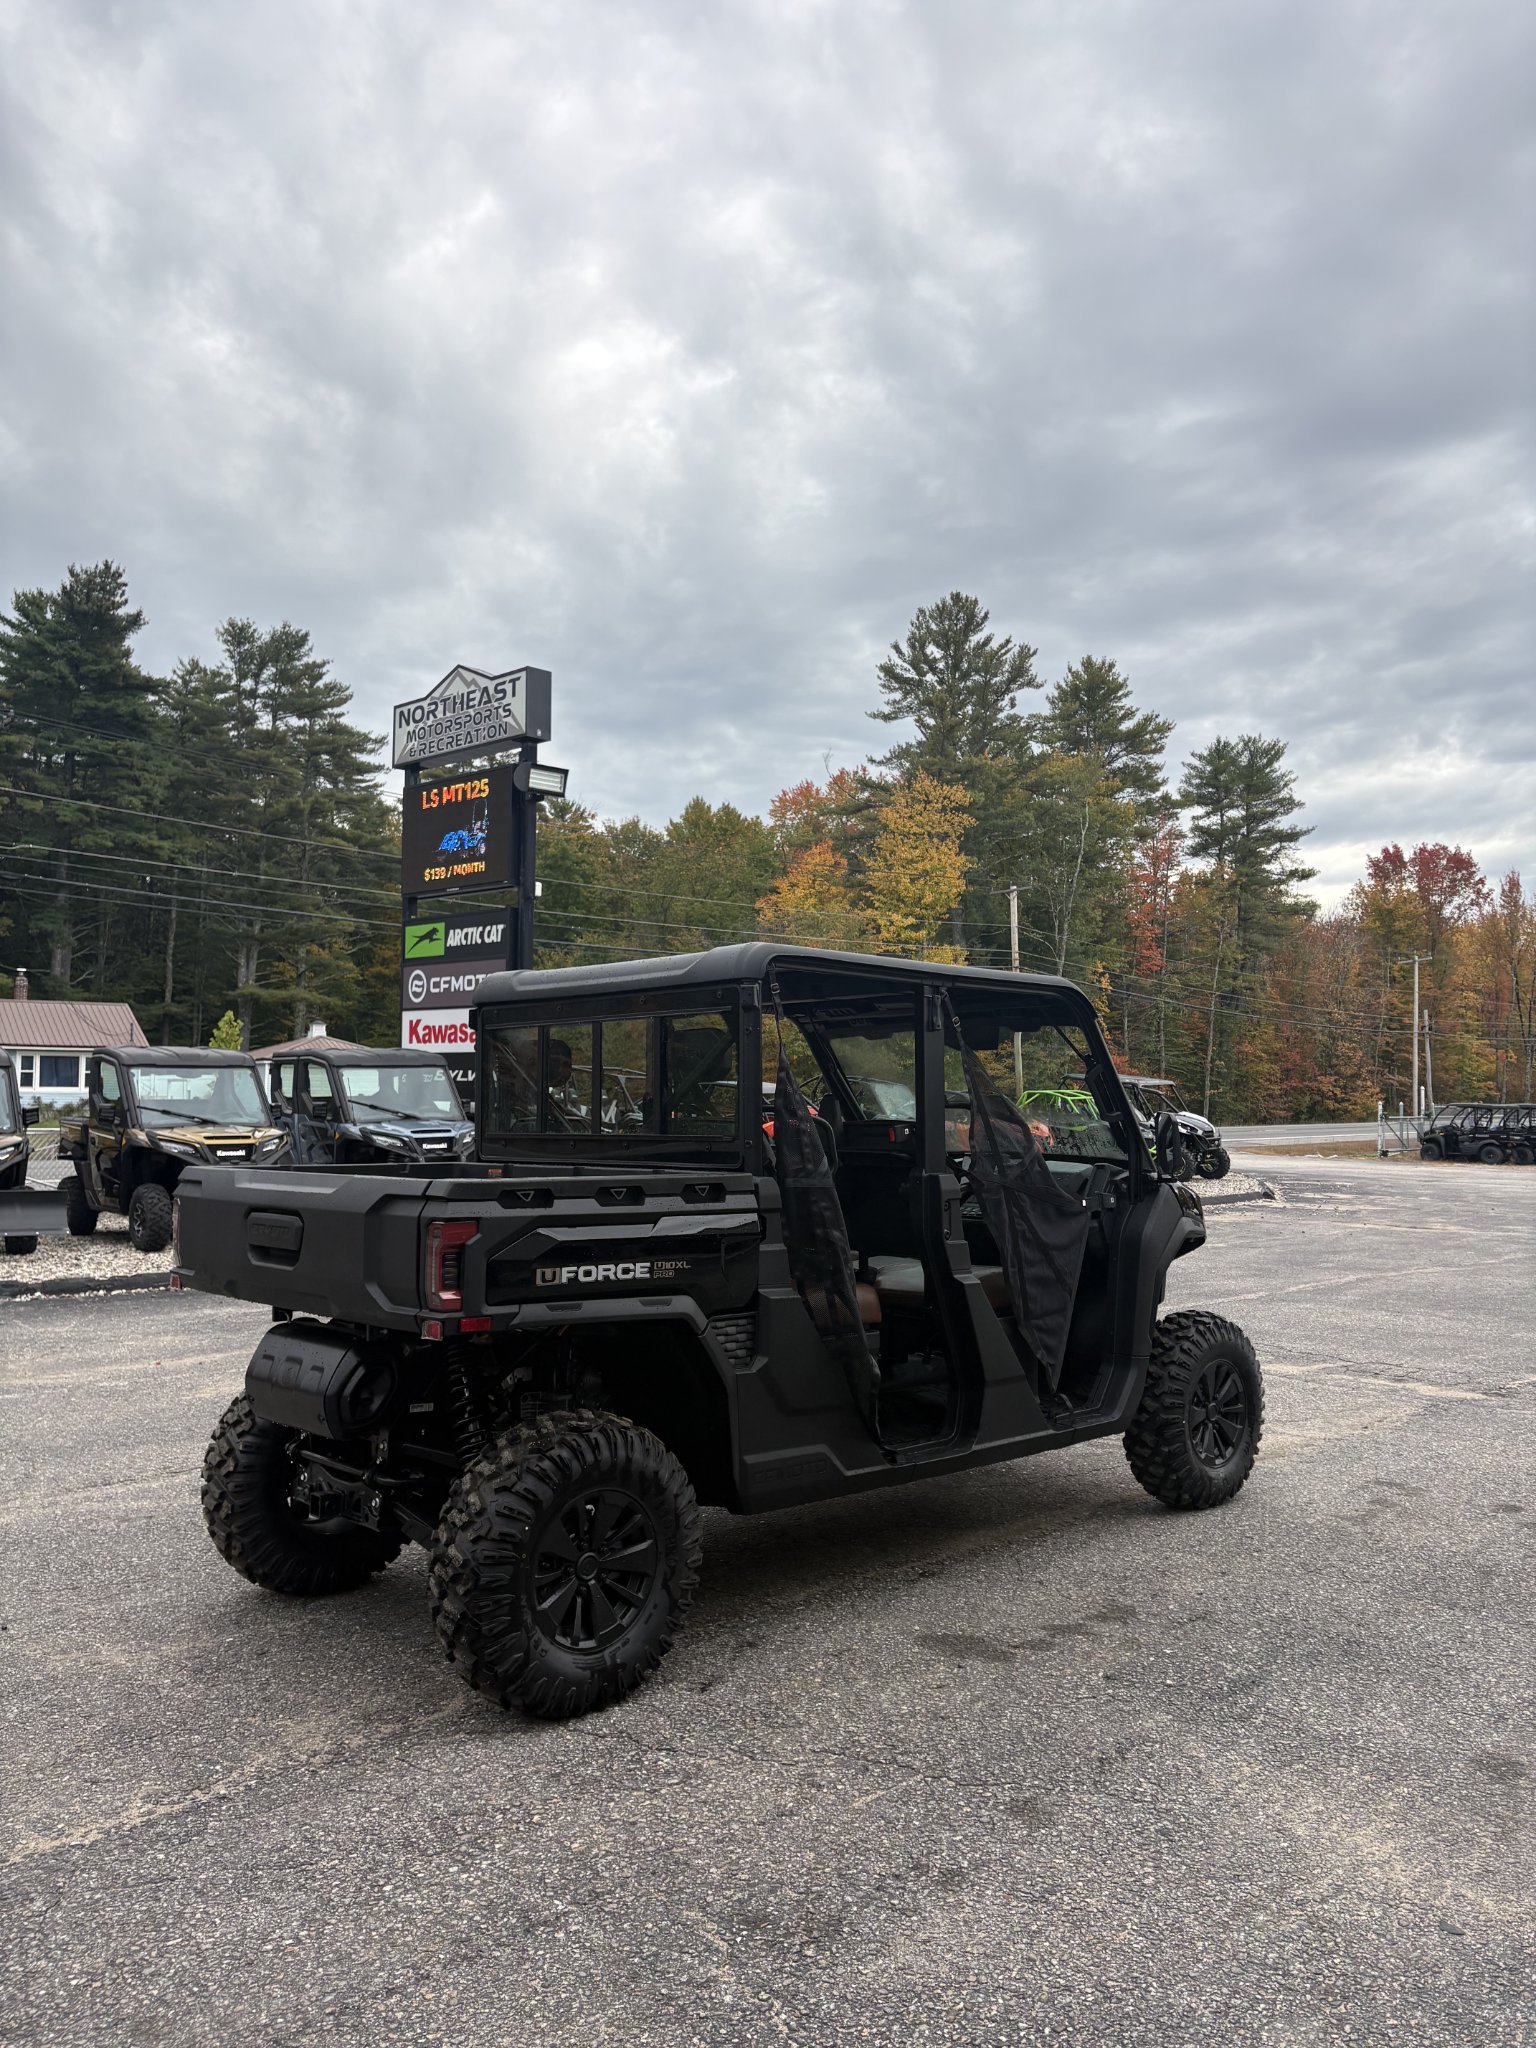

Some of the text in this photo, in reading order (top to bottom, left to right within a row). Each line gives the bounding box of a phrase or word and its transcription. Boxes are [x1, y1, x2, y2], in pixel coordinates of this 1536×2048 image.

[399, 676, 521, 729] NORTHEAST
[406, 703, 512, 744] MOTORSPORTS
[422, 778, 490, 810] LS MT125
[424, 866, 447, 882] $139
[453, 861, 486, 876] MONTH
[446, 924, 504, 947] ARCTIC CAT
[429, 973, 495, 993] CFMOT
[216, 1149, 246, 1157] Kawasaki
[654, 1270, 675, 1279] PRO
